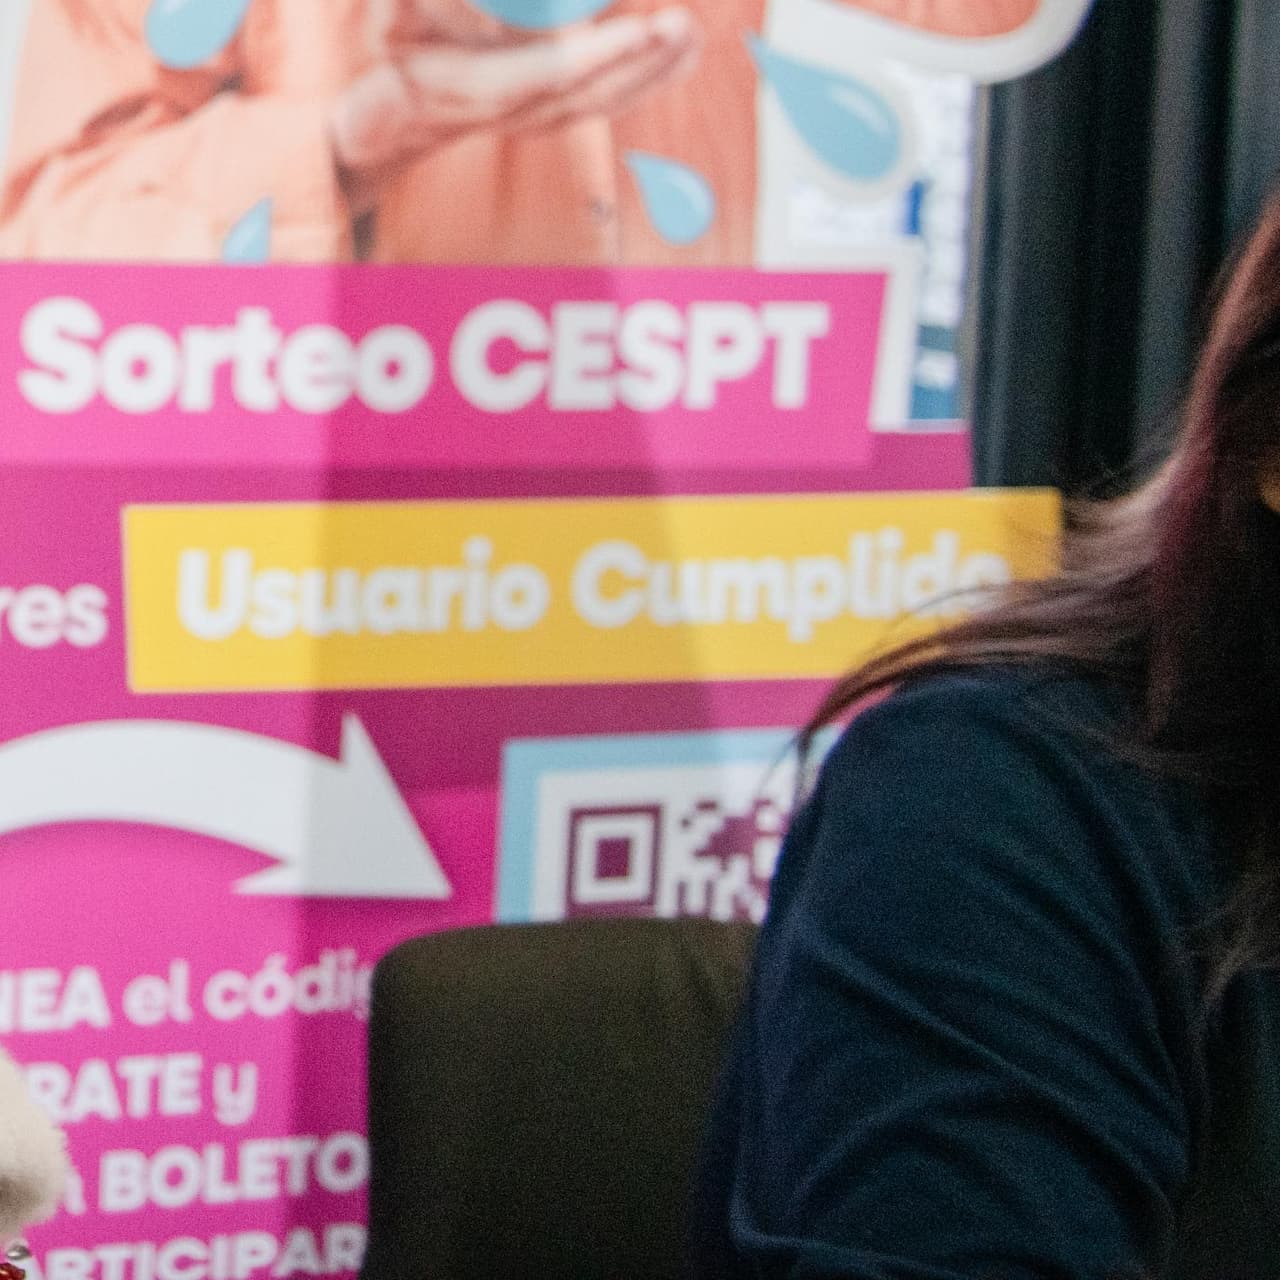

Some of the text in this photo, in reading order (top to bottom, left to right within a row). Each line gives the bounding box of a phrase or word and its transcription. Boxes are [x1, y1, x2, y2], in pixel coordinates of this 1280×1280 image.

[17, 297, 834, 415] Sorteo CESPT
[175, 527, 1011, 643] Usuario Cumplido
[123, 959, 195, 1026] el
[26, 1053, 258, 1127] RATE y
[99, 1131, 371, 1213] BOLETO
